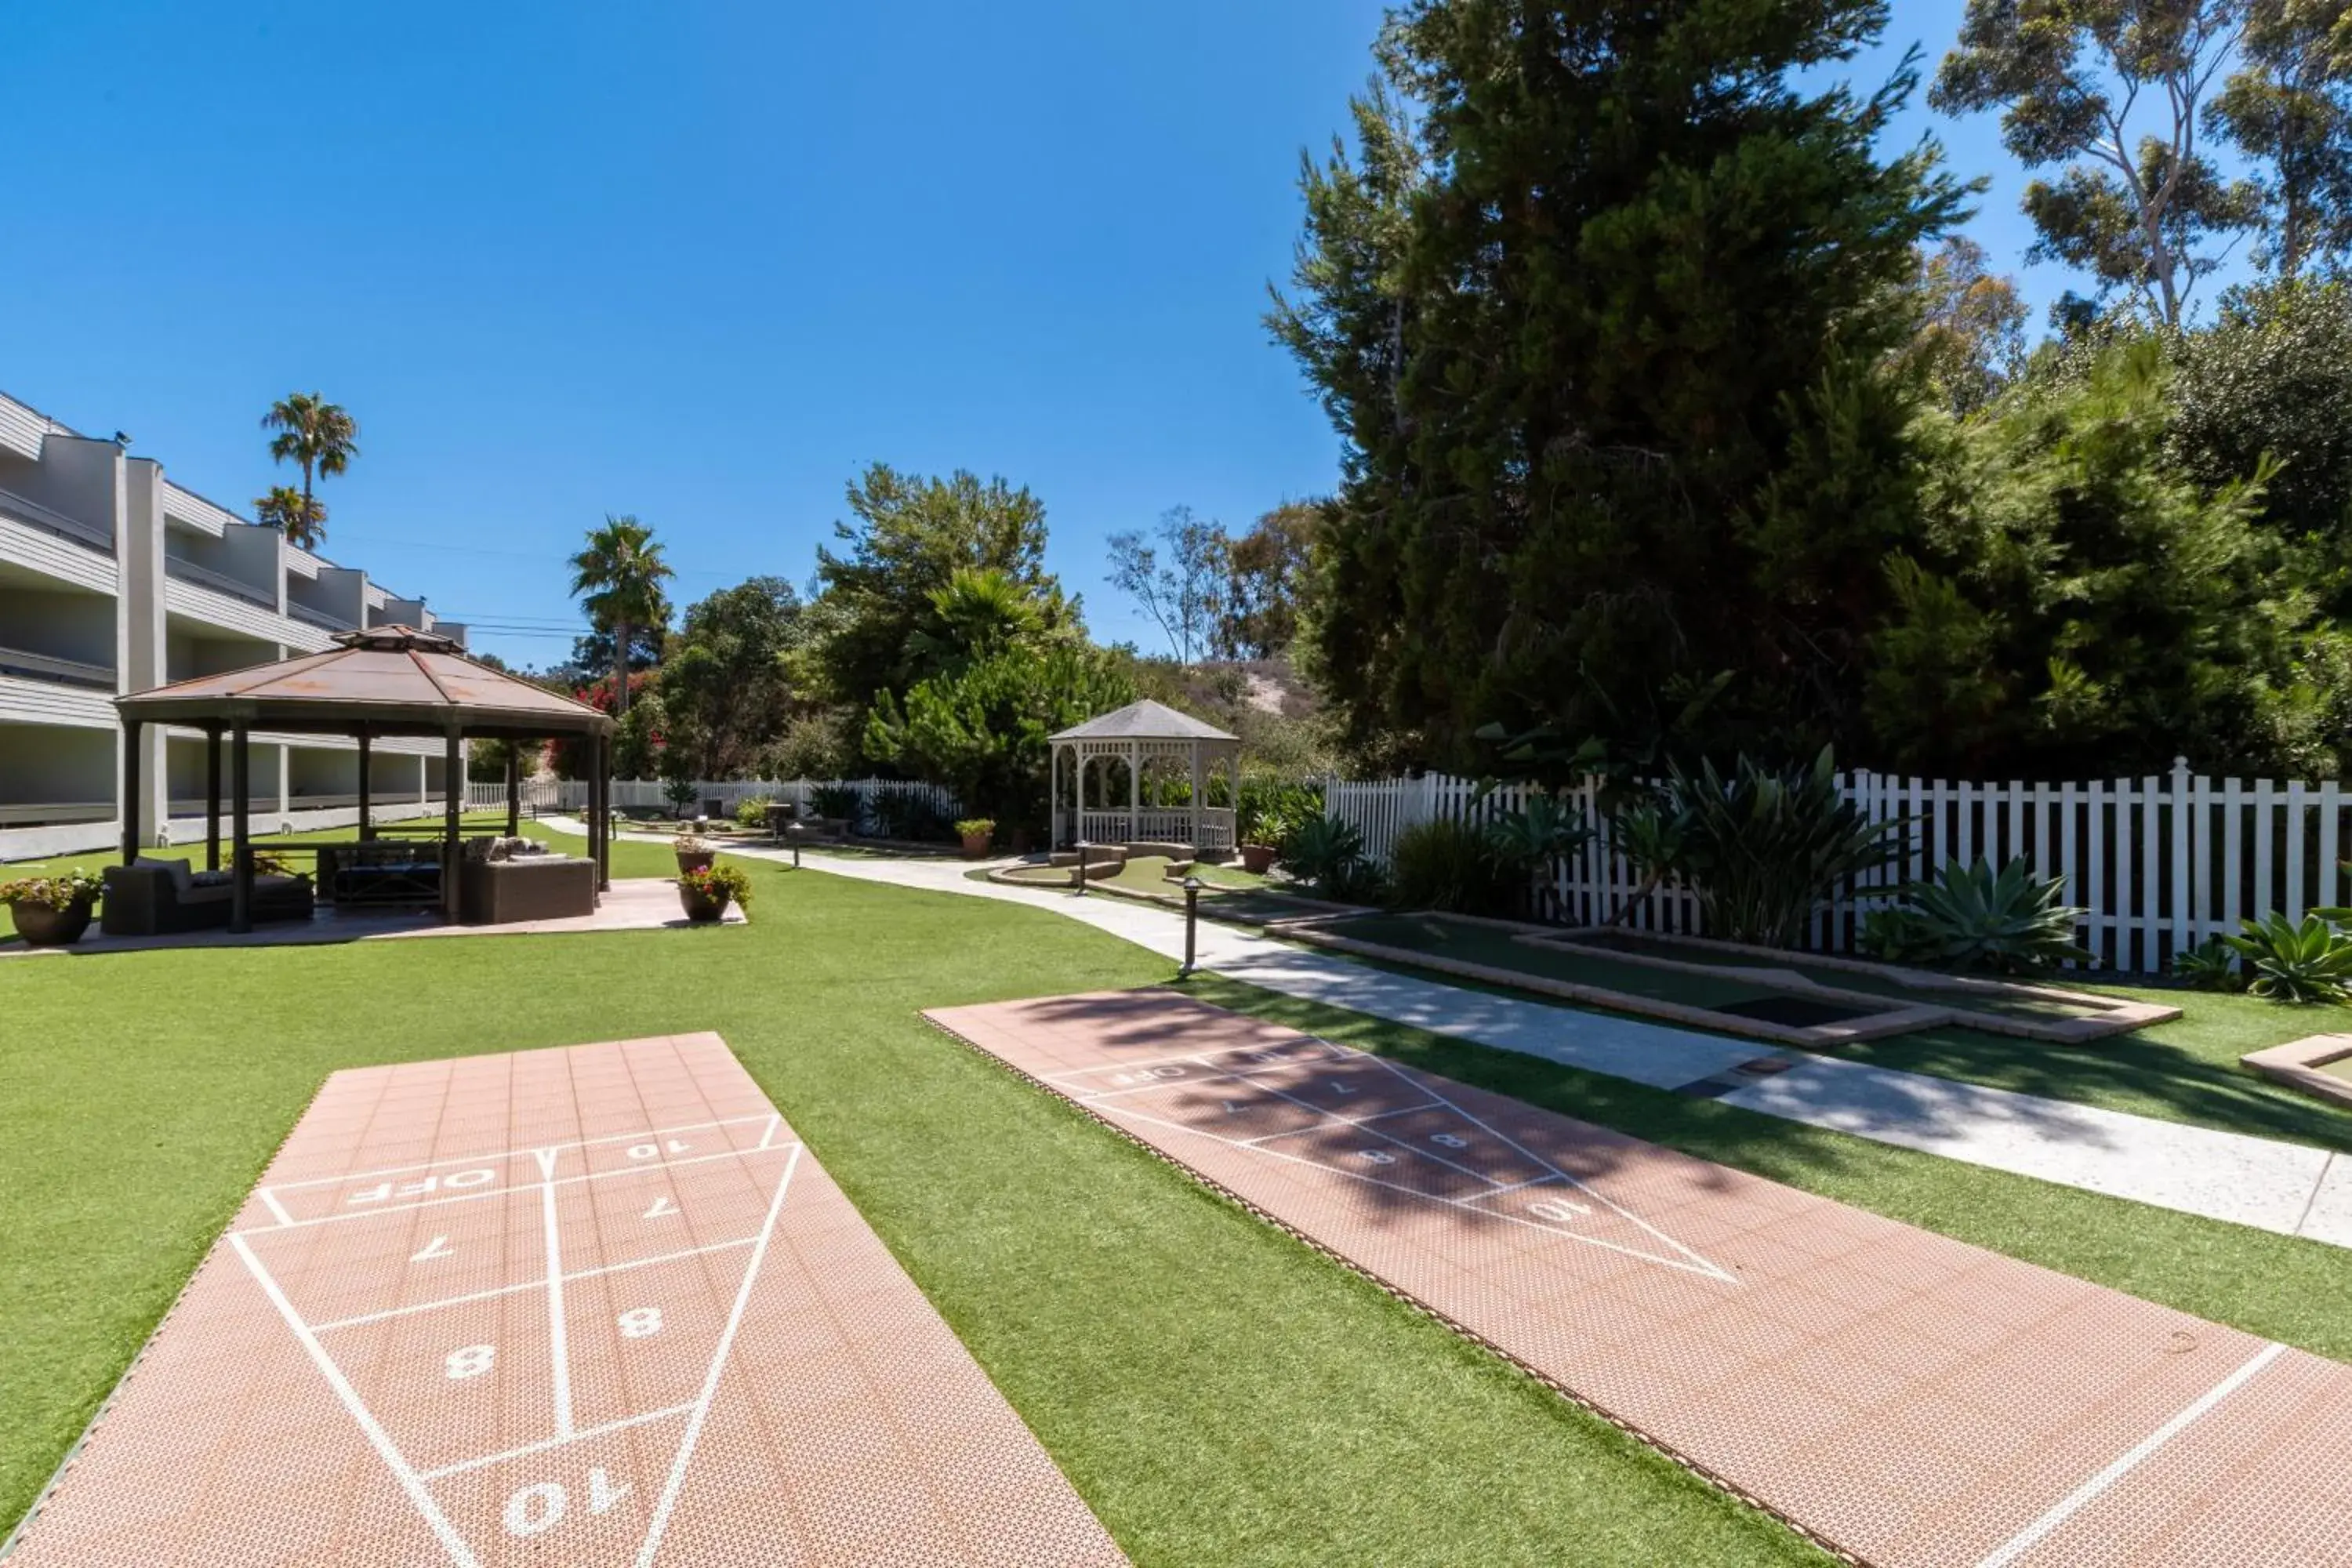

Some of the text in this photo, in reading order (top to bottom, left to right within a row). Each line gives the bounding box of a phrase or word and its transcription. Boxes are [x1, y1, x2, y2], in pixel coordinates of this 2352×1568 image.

[1359, 1150, 1396, 1164] 8
[1430, 1134, 1468, 1149] 8
[347, 1139, 691, 1204] 10 OFF
[617, 1307, 662, 1338] 8
[445, 1344, 496, 1379] 8
[502, 1468, 629, 1537] 10
